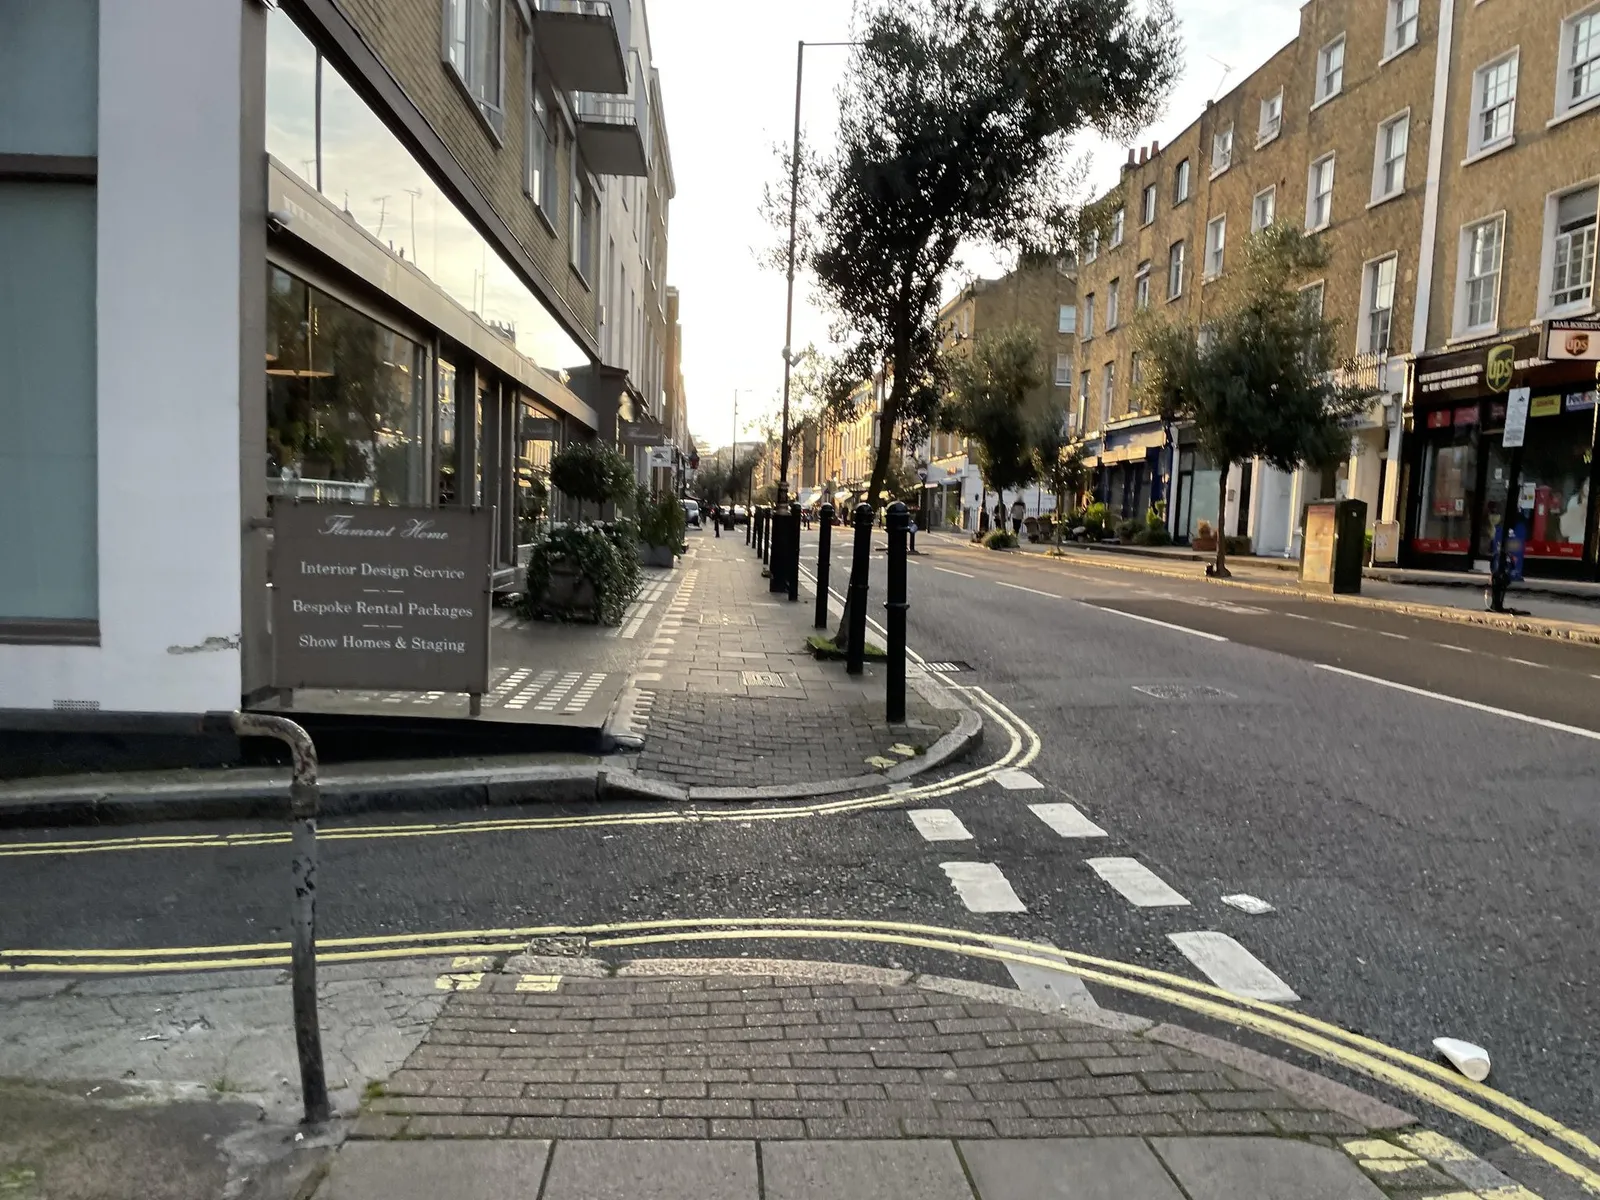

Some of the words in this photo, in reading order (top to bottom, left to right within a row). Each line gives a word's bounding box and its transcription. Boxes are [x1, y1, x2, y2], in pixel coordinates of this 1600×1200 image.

[1552, 320, 1569, 329] MAIL
[1566, 339, 1588, 354] ups
[1418, 363, 1483, 383] INTERNATIONAL
[1489, 358, 1513, 386] ups
[1440, 375, 1479, 389] COURIER
[400, 519, 449, 540] Home
[301, 561, 356, 575] Interior
[361, 563, 409, 580] Design
[414, 565, 465, 580] Service
[293, 600, 352, 615] Bespoke
[356, 601, 403, 615] Rental
[408, 603, 473, 619] Packages
[299, 635, 337, 647] Show
[343, 636, 391, 649] Homes
[395, 636, 406, 649] &
[411, 637, 465, 653] Staging
